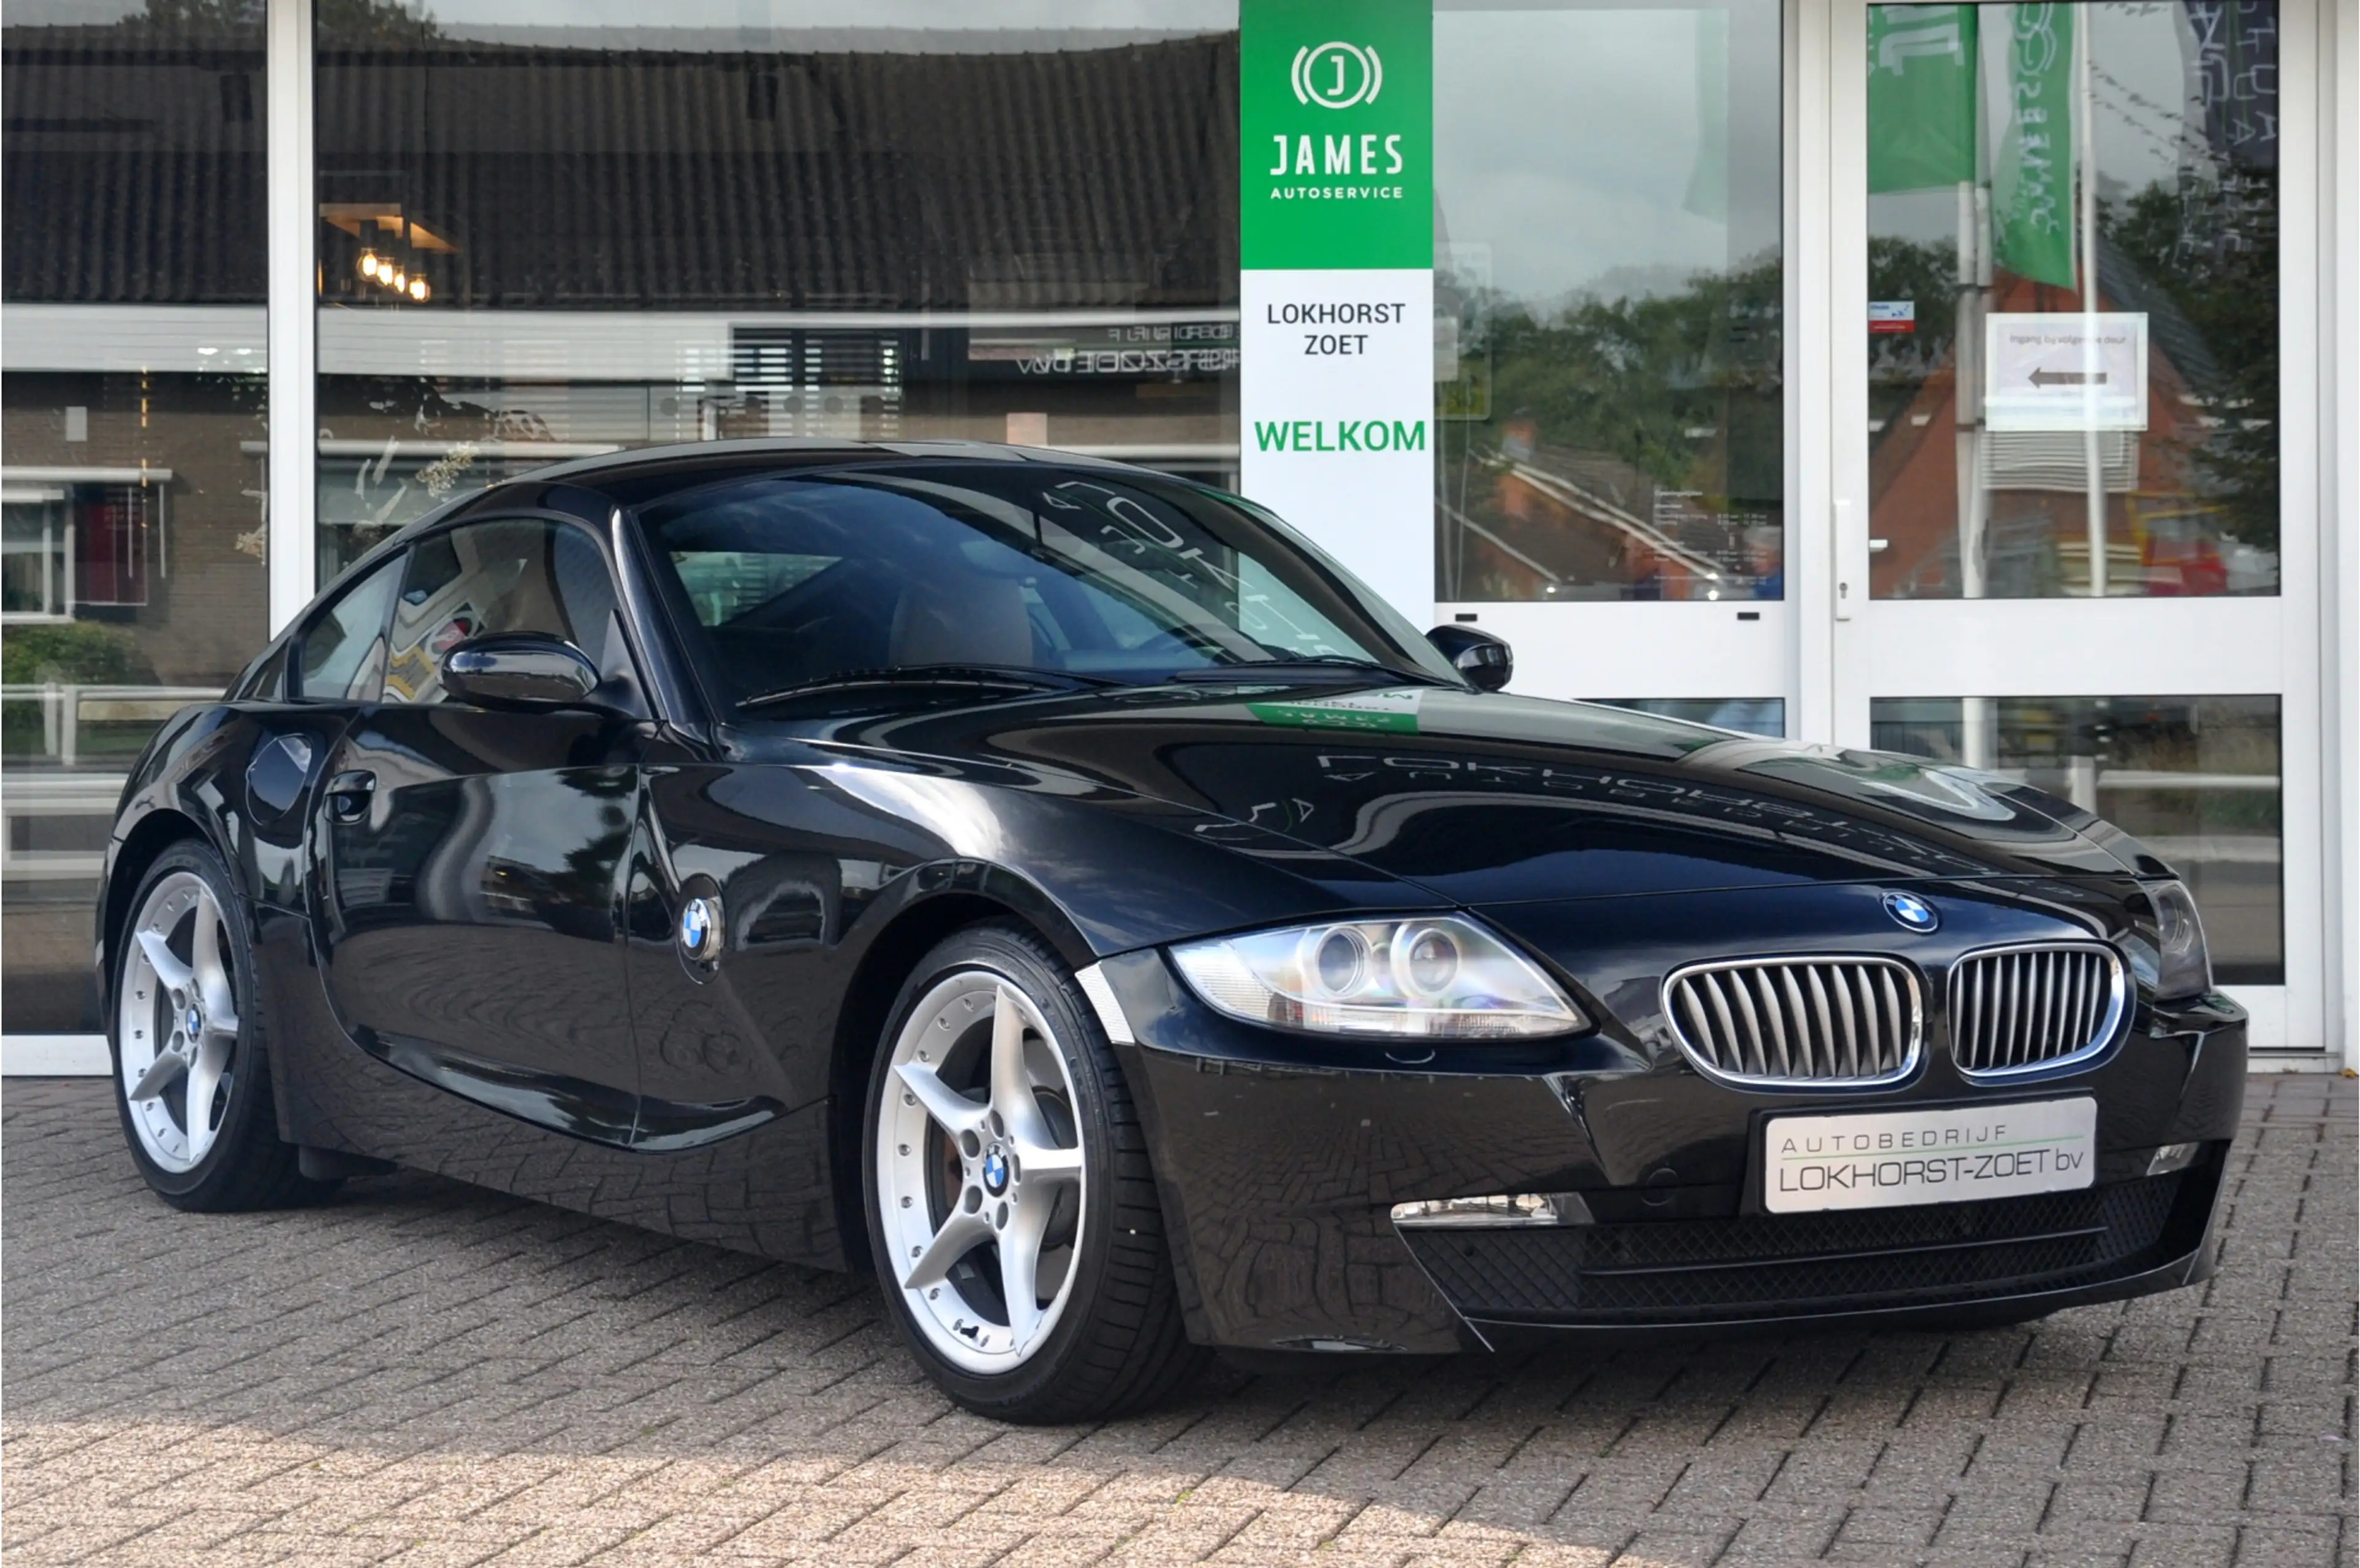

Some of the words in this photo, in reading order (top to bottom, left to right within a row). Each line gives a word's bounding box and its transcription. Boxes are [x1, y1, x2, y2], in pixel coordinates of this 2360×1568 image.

[1270, 134, 1403, 175] JAMES
[1270, 187, 1403, 199] AUTOSERVICE
[1268, 303, 1406, 324] LOKHORST
[1305, 334, 1368, 355] ZOET
[1254, 420, 1425, 452] WELKOM
[1781, 1124, 2008, 1154] AUTOBEDRIJF
[1779, 1148, 2050, 1193] LOKHORST-ZOET
[2055, 1148, 2084, 1172] bv
